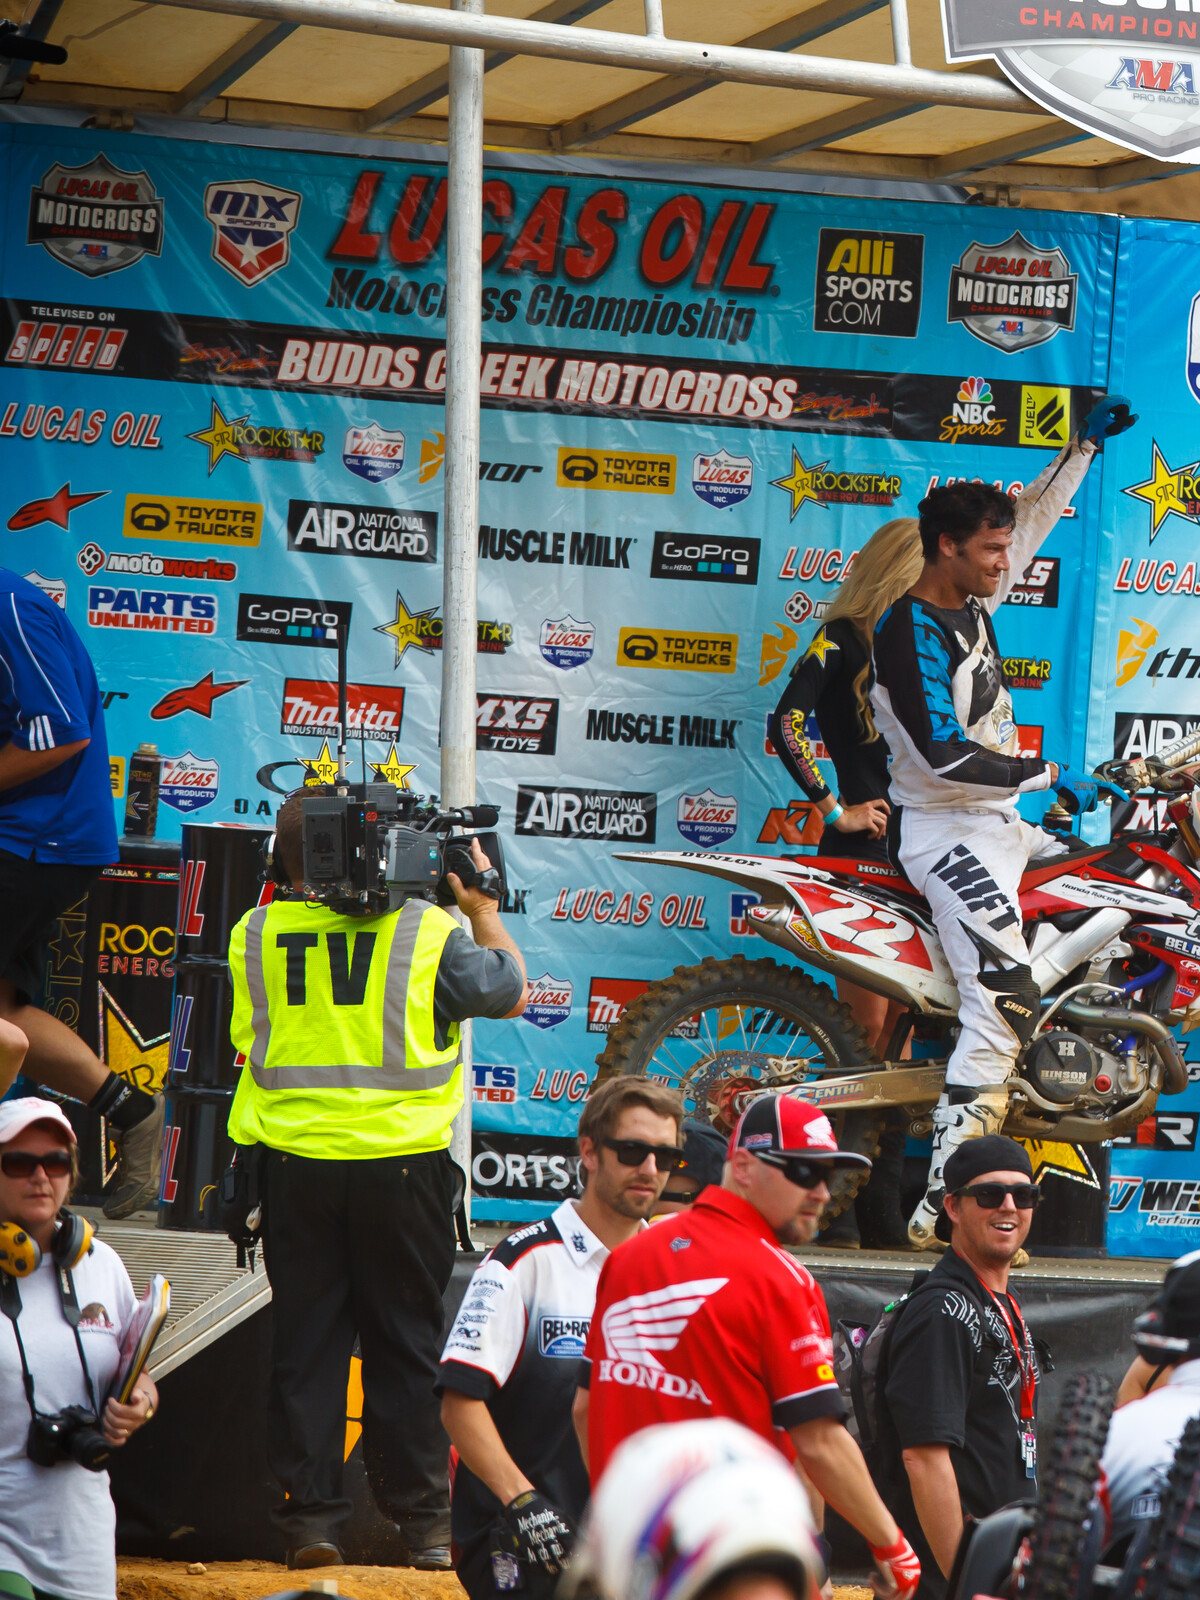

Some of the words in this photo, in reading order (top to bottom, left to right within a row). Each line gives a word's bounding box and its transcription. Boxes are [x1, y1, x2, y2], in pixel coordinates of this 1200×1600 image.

[1106, 57, 1199, 96] AMA
[1133, 92, 1155, 103] PRO
[1158, 94, 1200, 106] RACING
[56, 177, 111, 198] LUCAS
[111, 180, 139, 201] OIL
[37, 198, 157, 233] MOTOCROSS
[227, 217, 276, 229] SPORTS
[637, 192, 779, 297] OIL
[975, 256, 1025, 276] LUCAS
[1028, 258, 1053, 277] OIL
[825, 275, 913, 303] SPORTS
[957, 276, 1070, 309] MOTOCROSS
[32, 306, 95, 320] TELEVISED
[98, 312, 116, 322] ON
[824, 300, 882, 326] .COM
[970, 304, 1052, 316] CHAMPIONSHIP
[6, 326, 124, 369] SPEED
[277, 339, 420, 390] BUDDS
[424, 346, 558, 399] CEEK
[554, 359, 799, 421] MOTOCROSS
[951, 403, 996, 425] NBC
[0, 402, 107, 443] LUCAS
[111, 411, 163, 449] OIL
[939, 415, 1007, 445] Sports
[350, 440, 402, 458] LUCAS
[346, 458, 360, 466] OIL
[362, 460, 401, 470] PRODUCTS
[604, 457, 671, 473] TOYOTA
[602, 471, 670, 487] TRUCKS
[699, 466, 750, 484] LUCAS
[695, 484, 710, 494] OIL
[711, 486, 749, 497] PRODUCTS
[818, 490, 860, 502] ENERGY
[862, 493, 894, 506] DRINK
[176, 505, 256, 523] TOYOTA
[174, 521, 255, 538] TRUCKS
[294, 507, 356, 550] AIR
[358, 512, 427, 532] NATIONAL
[354, 528, 429, 556] GUARD
[478, 525, 565, 565] MUSCLE
[569, 531, 633, 569] MILK
[662, 541, 749, 562] GoPro
[89, 586, 216, 619] PARTS
[89, 611, 215, 634] UNLIMITED
[247, 603, 339, 626] GoPro
[546, 631, 591, 647] LUCAS
[663, 637, 732, 652] TOYOTA
[556, 649, 593, 658] PRODUCTS
[663, 651, 731, 666] TRUCKS
[1012, 677, 1043, 689] DRINK
[586, 709, 674, 746] MUSCLE
[678, 715, 741, 749] MILK
[490, 736, 541, 751] TOYS
[162, 771, 216, 787] LUCAS
[174, 789, 215, 798] PRODUCTS
[524, 791, 582, 832] AIR
[584, 795, 646, 813] NATIONAL
[684, 805, 734, 823] LUCAS
[580, 810, 647, 837] GUARD
[680, 824, 693, 832] OIL
[694, 825, 734, 834] PRODUCTS
[847, 886, 879, 901] REED
[1061, 882, 1091, 896] Honda
[1091, 891, 1122, 905] Racing
[551, 887, 654, 925] LUCAS
[659, 893, 708, 929] OIL
[813, 889, 917, 961] 22
[276, 931, 378, 1006] TV
[533, 1007, 570, 1016] PRODUCTS
[1002, 1000, 1032, 1019] SHIFT
[1041, 1070, 1087, 1084] HINSON
[507, 1220, 549, 1247] SHIFT
[598, 1358, 713, 1406] HONDA
